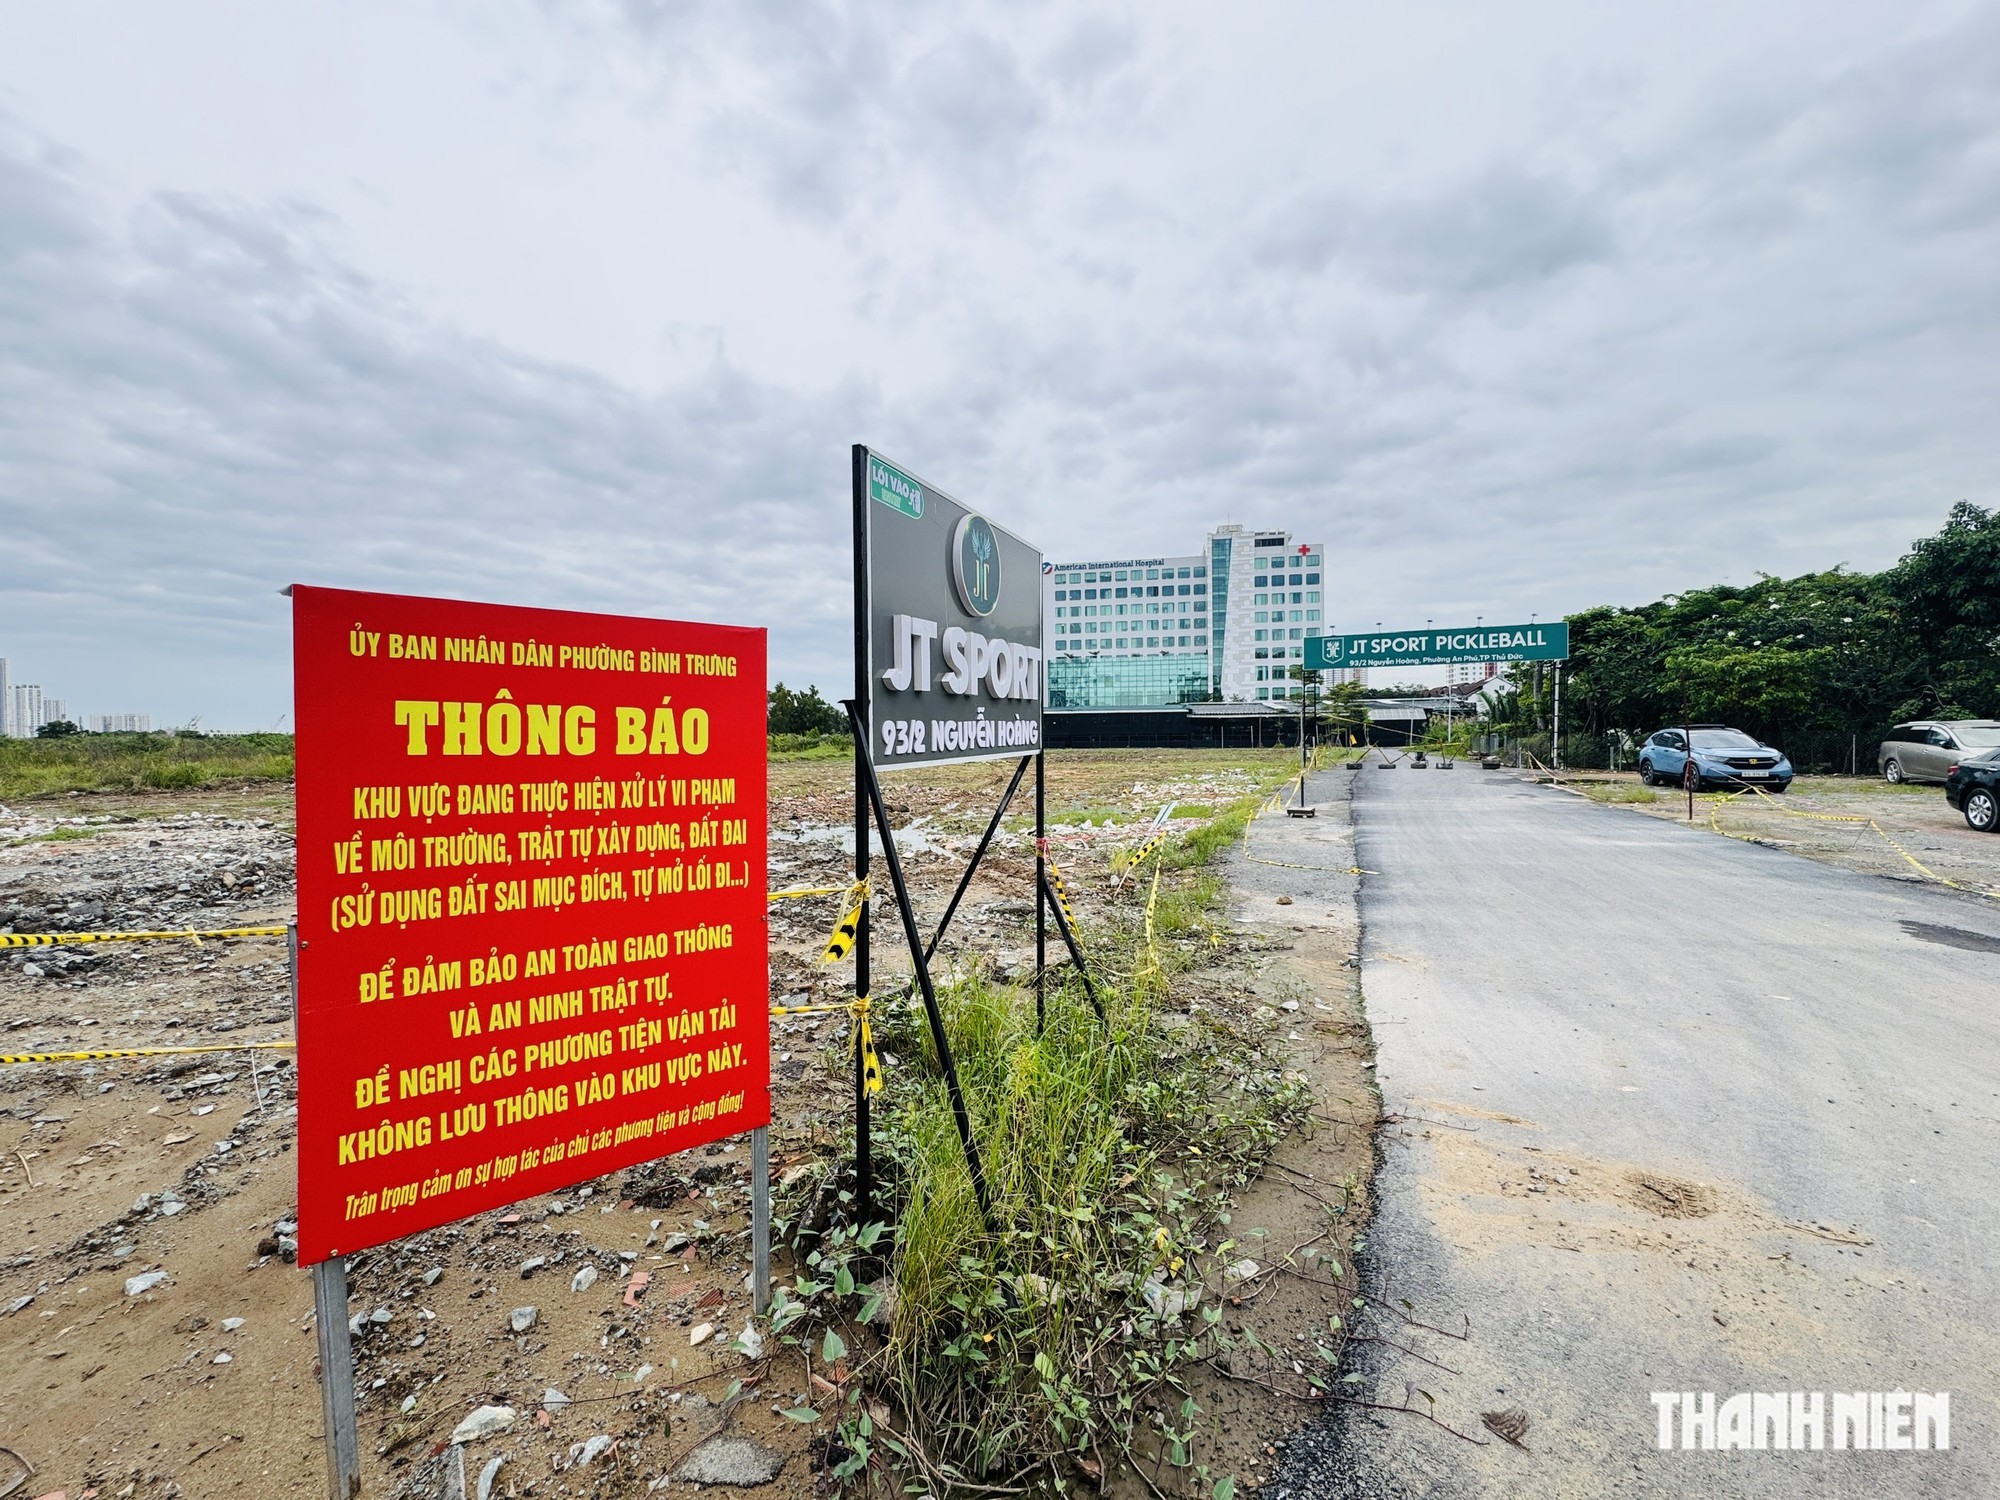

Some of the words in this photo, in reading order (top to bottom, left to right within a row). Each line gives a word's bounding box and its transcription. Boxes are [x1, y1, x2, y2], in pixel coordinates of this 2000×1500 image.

[890, 475, 909, 498] VÀO
[1054, 564, 1087, 572] American
[1088, 560, 1134, 570] International
[1135, 558, 1164, 568] Hospital
[349, 623, 381, 657] ỦY
[388, 633, 437, 661] BAN
[444, 635, 505, 665] NHÂN
[511, 639, 554, 668] DÂN
[559, 644, 635, 672] PHƯỜNG
[639, 647, 681, 674] BÌNH
[685, 653, 737, 677] TRƯNG
[882, 615, 937, 692] JT
[941, 627, 1041, 700] SPORT
[1349, 640, 1367, 654] JT
[1371, 636, 1429, 654] SPORT
[1435, 630, 1547, 651] PICKLEBALL
[1349, 659, 1367, 667] 93/2
[1368, 657, 1395, 667] Nguyễn
[1423, 655, 1450, 665] Phường
[1452, 655, 1463, 663] An
[1491, 653, 1506, 661] Thủ
[1507, 652, 1524, 661] Đức
[394, 687, 596, 757] THÔNG
[615, 695, 709, 756] BÁO
[882, 719, 926, 756] 93/2
[931, 707, 995, 752] NGUYỄN
[998, 714, 1039, 748] HOÀNG
[353, 786, 401, 820] KHU
[407, 782, 451, 824] VỰC
[456, 782, 514, 816] ĐANG
[519, 780, 569, 817] THỰC
[574, 776, 616, 815] HIỆN
[620, 772, 645, 809] XỬ
[648, 775, 667, 808] LÝ
[671, 778, 687, 807] VI
[690, 777, 736, 810] PHẠM
[333, 829, 364, 875] VỀ
[371, 831, 416, 872] MÔI
[421, 827, 512, 868] TRƯỜNG,
[517, 824, 565, 866] TRẬT
[569, 825, 594, 868] TỰ
[597, 821, 631, 856] XÂY
[635, 821, 685, 855] DỰNG,
[688, 811, 719, 849] ĐẤT
[721, 818, 747, 846] ĐAI
[331, 881, 376, 933] (SỬ
[380, 887, 442, 929] DỤNG
[447, 872, 489, 920] ĐẤT
[494, 879, 527, 912] SAI
[532, 875, 576, 912] MỤC
[580, 866, 628, 903] ĐÍCH,
[631, 866, 654, 898] TỰ
[657, 857, 684, 895] MỞ
[687, 854, 712, 892] LỐI
[714, 861, 749, 889] ĐI...)
[358, 957, 396, 1004] ĐỂ
[402, 954, 462, 997] ĐẢM
[469, 946, 517, 987] BẢO
[524, 948, 556, 978] AN
[561, 939, 618, 972] TOÀN
[623, 931, 669, 963] GIAO
[673, 923, 733, 955] THÔNG
[449, 1000, 482, 1039] VÀ
[488, 999, 522, 1032] AN
[528, 988, 584, 1025] NINH
[588, 977, 639, 1015] TRẬT
[643, 971, 673, 1005] TỰ.
[355, 1064, 391, 1109] ĐỀ
[399, 1059, 462, 1101] NGHỊ
[469, 1044, 517, 1085] CÁC
[524, 1028, 613, 1073] PHƯƠNG
[618, 1015, 662, 1058] TIỆN
[667, 1009, 705, 1046] VẬN
[708, 998, 736, 1032] TẢI
[338, 1116, 432, 1166] KHÔNG
[440, 1103, 487, 1142] LƯU
[493, 1084, 569, 1128] THÔNG
[574, 1070, 616, 1108] VÀO
[621, 1062, 661, 1096] KHU
[666, 1053, 703, 1090] VỰC
[707, 1042, 747, 1075] NÀY.
[345, 1190, 378, 1222] Trân
[380, 1179, 419, 1215] trọng
[421, 1168, 453, 1200] cảm
[454, 1167, 473, 1191] ơn
[474, 1163, 492, 1189] sự
[493, 1153, 518, 1184] hợp
[519, 1148, 541, 1172] tác
[542, 1141, 566, 1165] của
[567, 1132, 590, 1158] chủ
[591, 1129, 613, 1152] các
[614, 1118, 655, 1149] phương
[655, 1110, 676, 1133] tiện
[678, 1108, 691, 1129] và
[691, 1101, 717, 1128] cộng
[717, 1088, 744, 1119] đồng!
